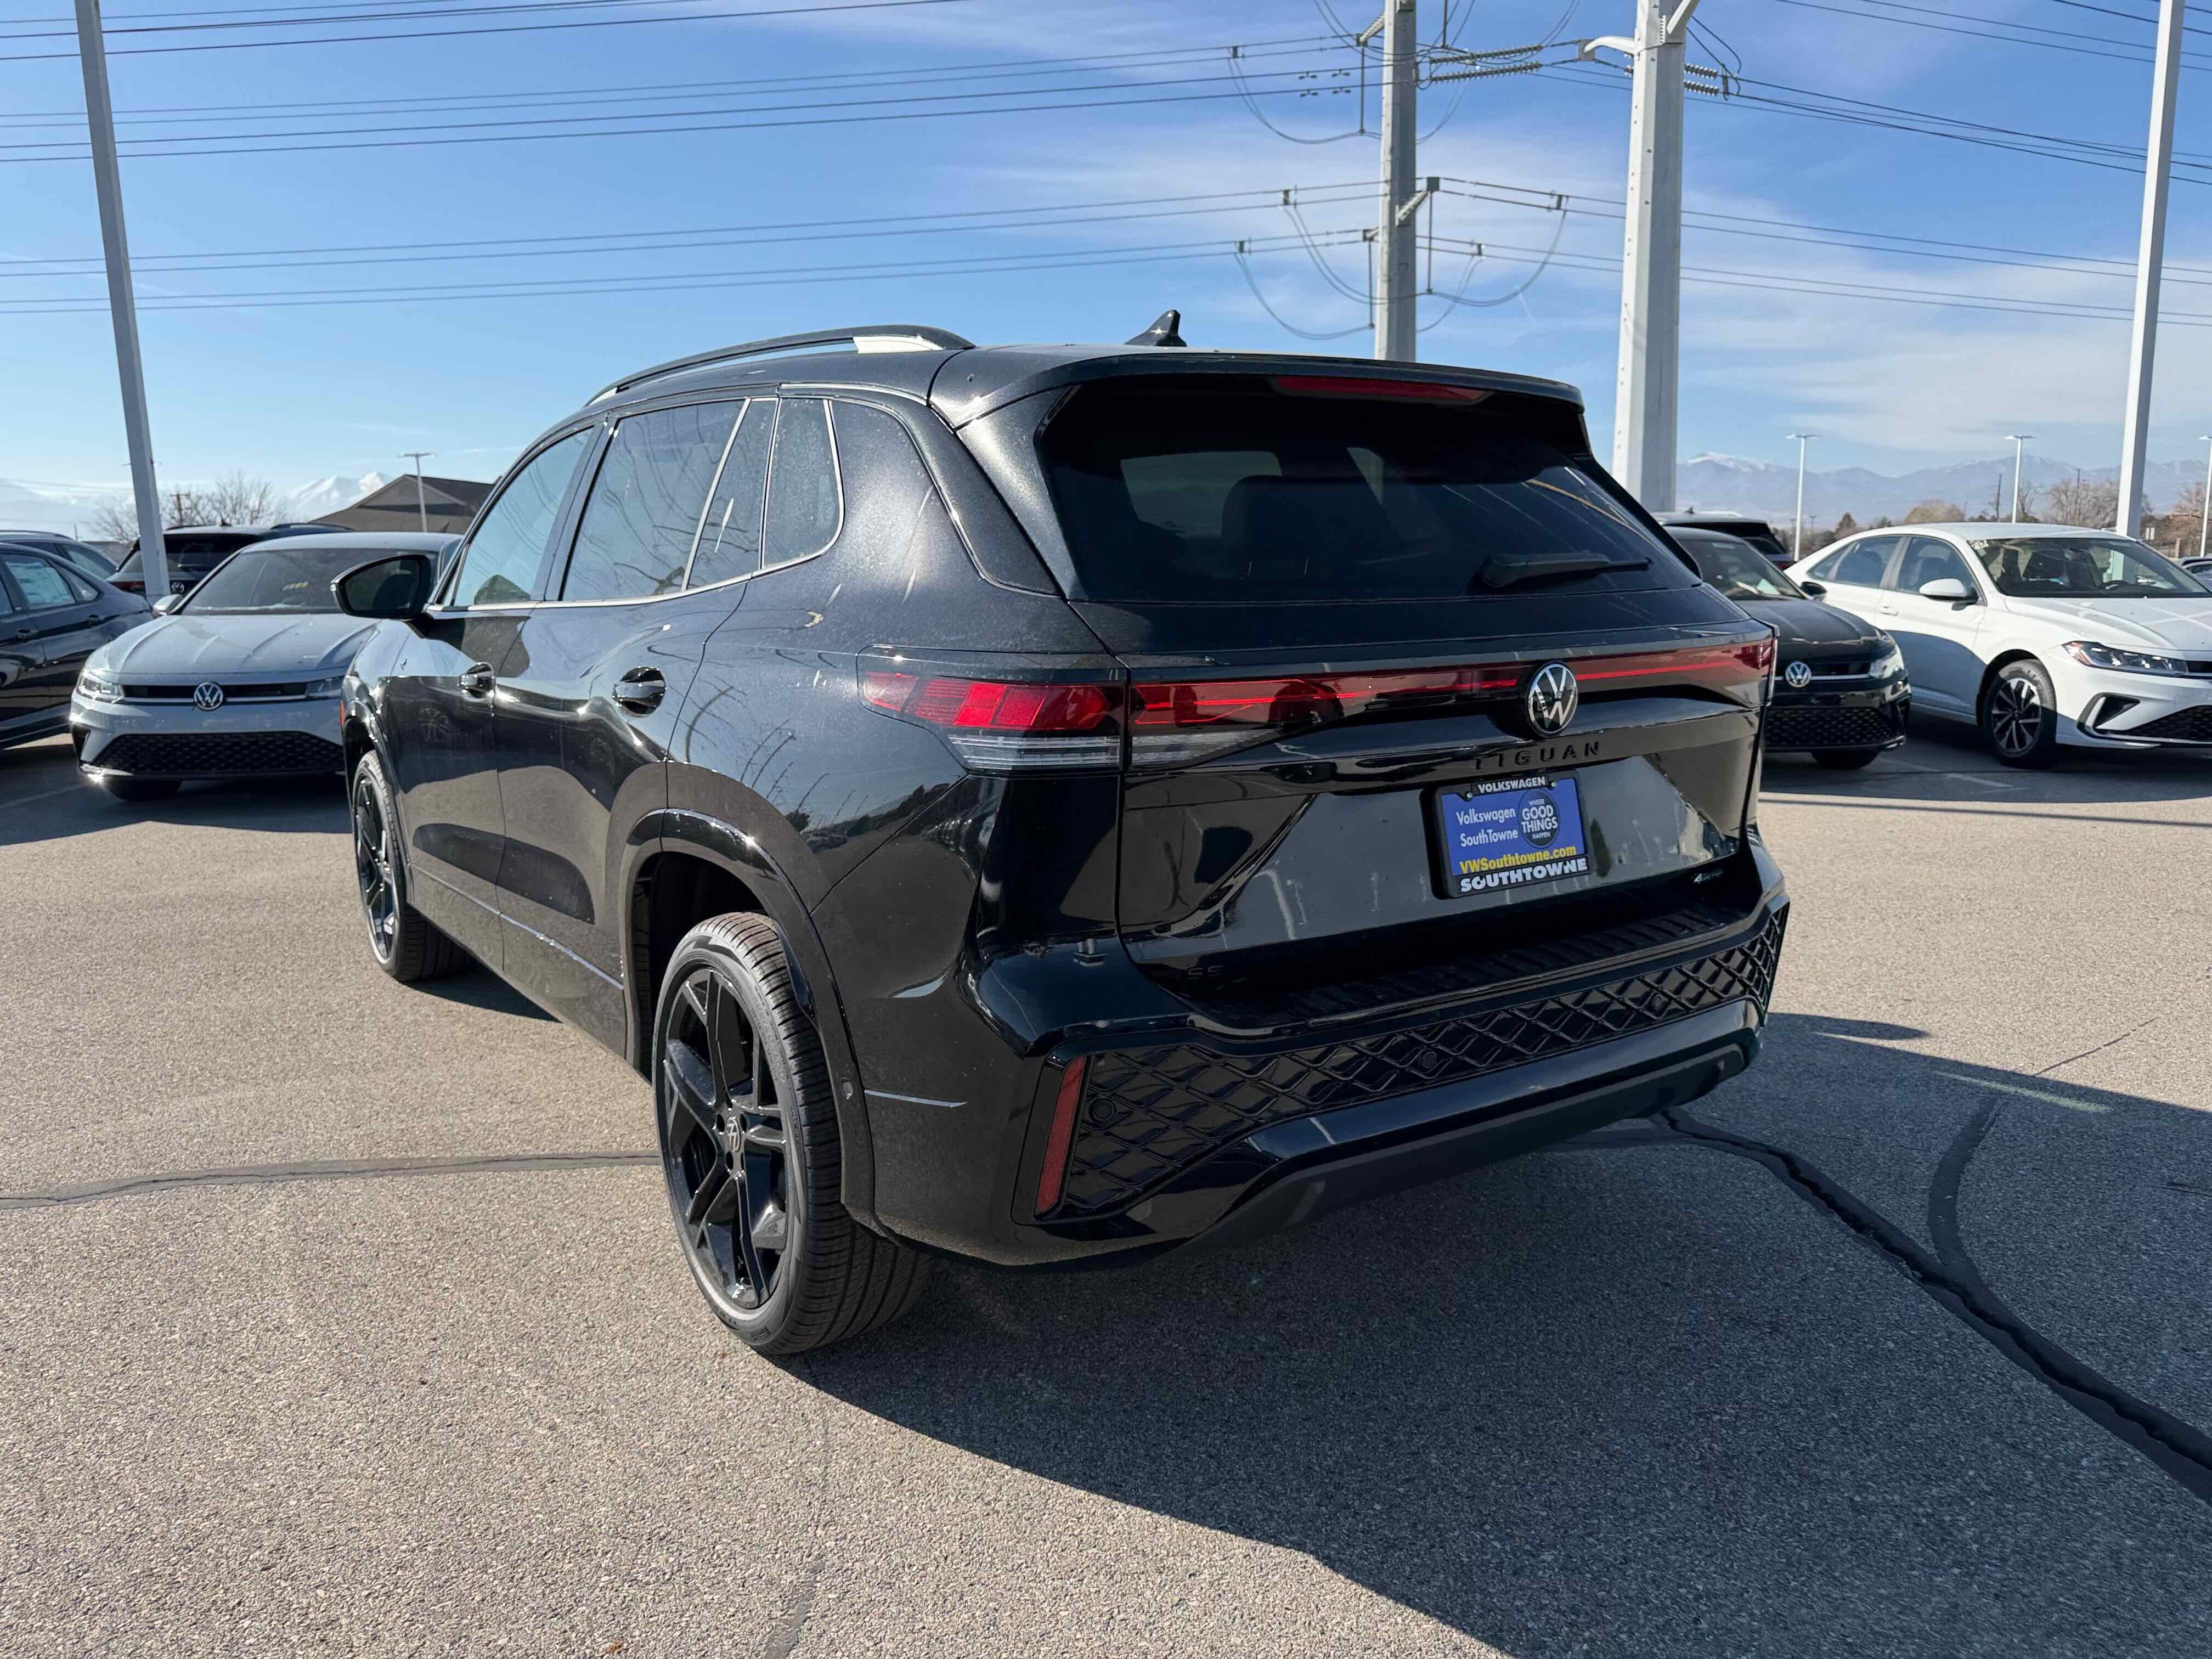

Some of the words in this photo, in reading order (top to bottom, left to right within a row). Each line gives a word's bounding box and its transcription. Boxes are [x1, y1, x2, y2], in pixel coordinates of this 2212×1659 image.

[1786, 662, 1812, 687] VW
[194, 682, 223, 710] VW
[1528, 662, 1578, 736] VW
[1474, 741, 1599, 770] TIGUAN
[1478, 777, 1545, 793] VOLKSWAGEN
[1457, 808, 1515, 825] Volkswagen
[1522, 804, 1554, 821] GOOD
[1521, 817, 1558, 834] THINGS
[1532, 832, 1551, 840] HAPPEN
[1460, 829, 1518, 847] SouthTowne
[1460, 846, 1576, 874] VWSouthtowne.com
[1460, 859, 1588, 892] SOUTHTOWNE
